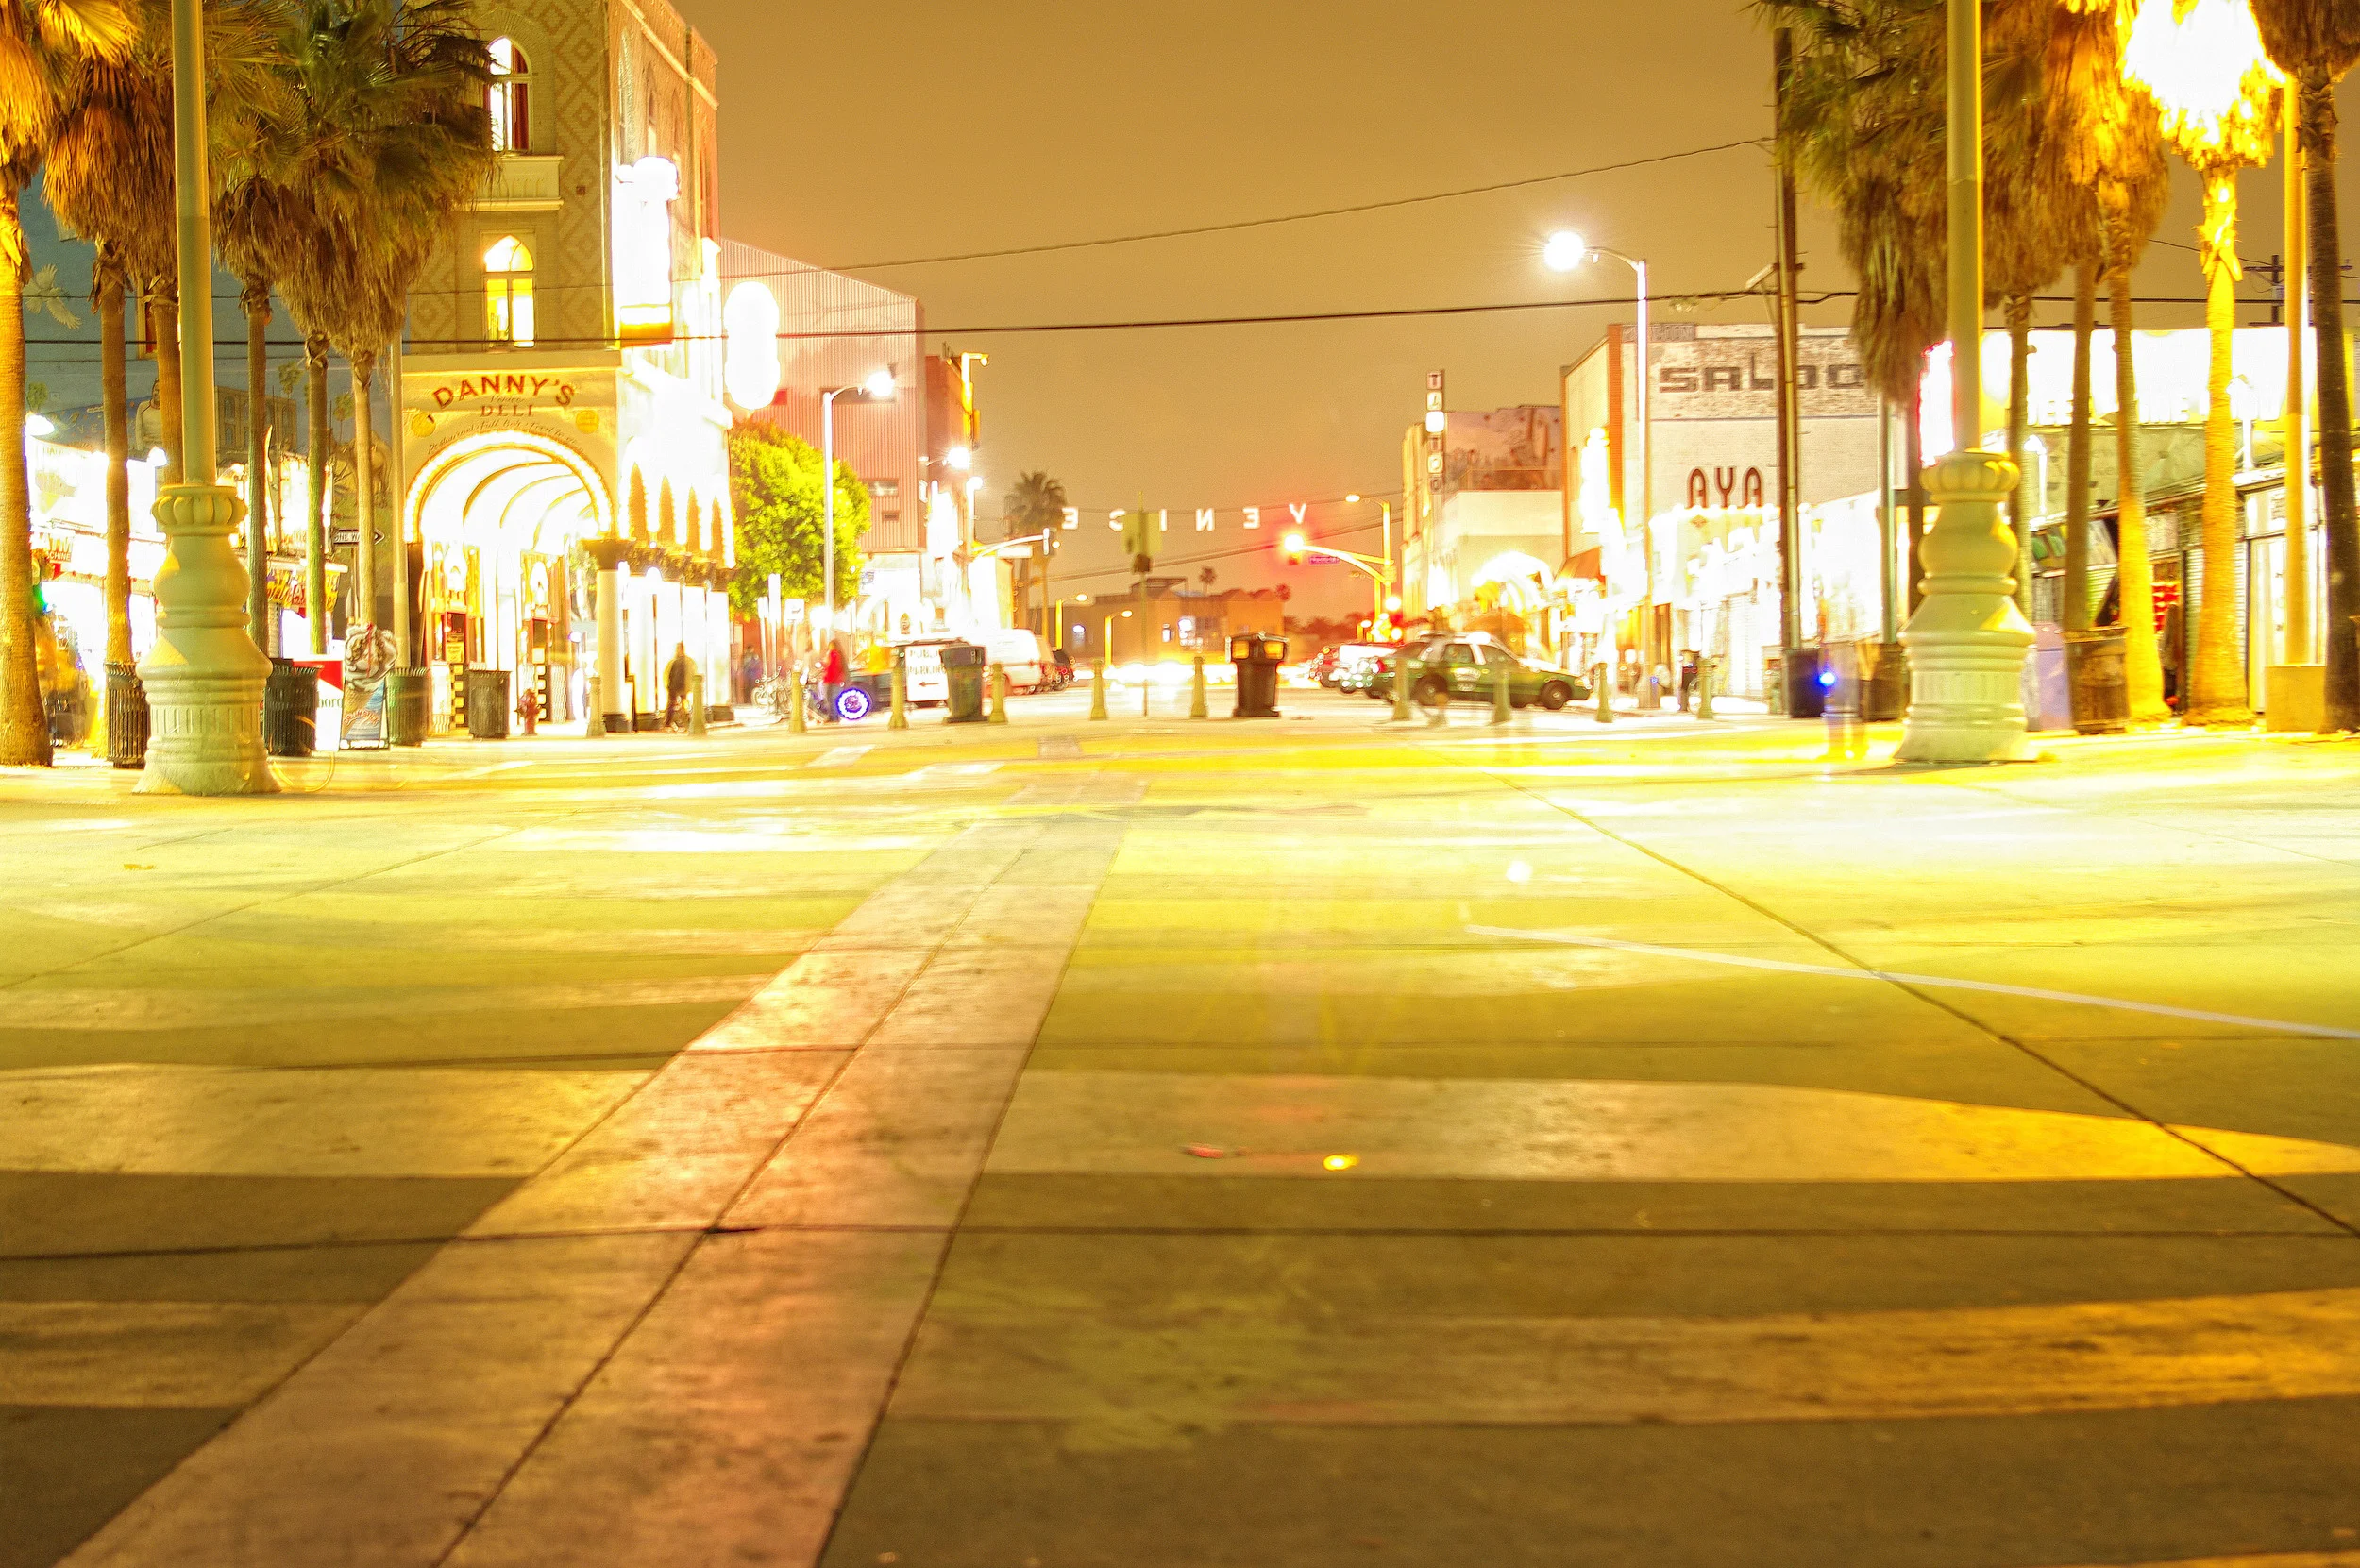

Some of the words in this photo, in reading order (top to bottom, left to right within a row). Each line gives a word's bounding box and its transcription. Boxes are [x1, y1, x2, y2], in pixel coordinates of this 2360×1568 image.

[432, 374, 576, 410] DANNY'S
[480, 404, 535, 417] DELI
[1425, 370, 1444, 493] TTOO
[1687, 467, 1762, 507] AYA
[47, 551, 71, 563] CHINE
[909, 649, 939, 658] PUBLI
